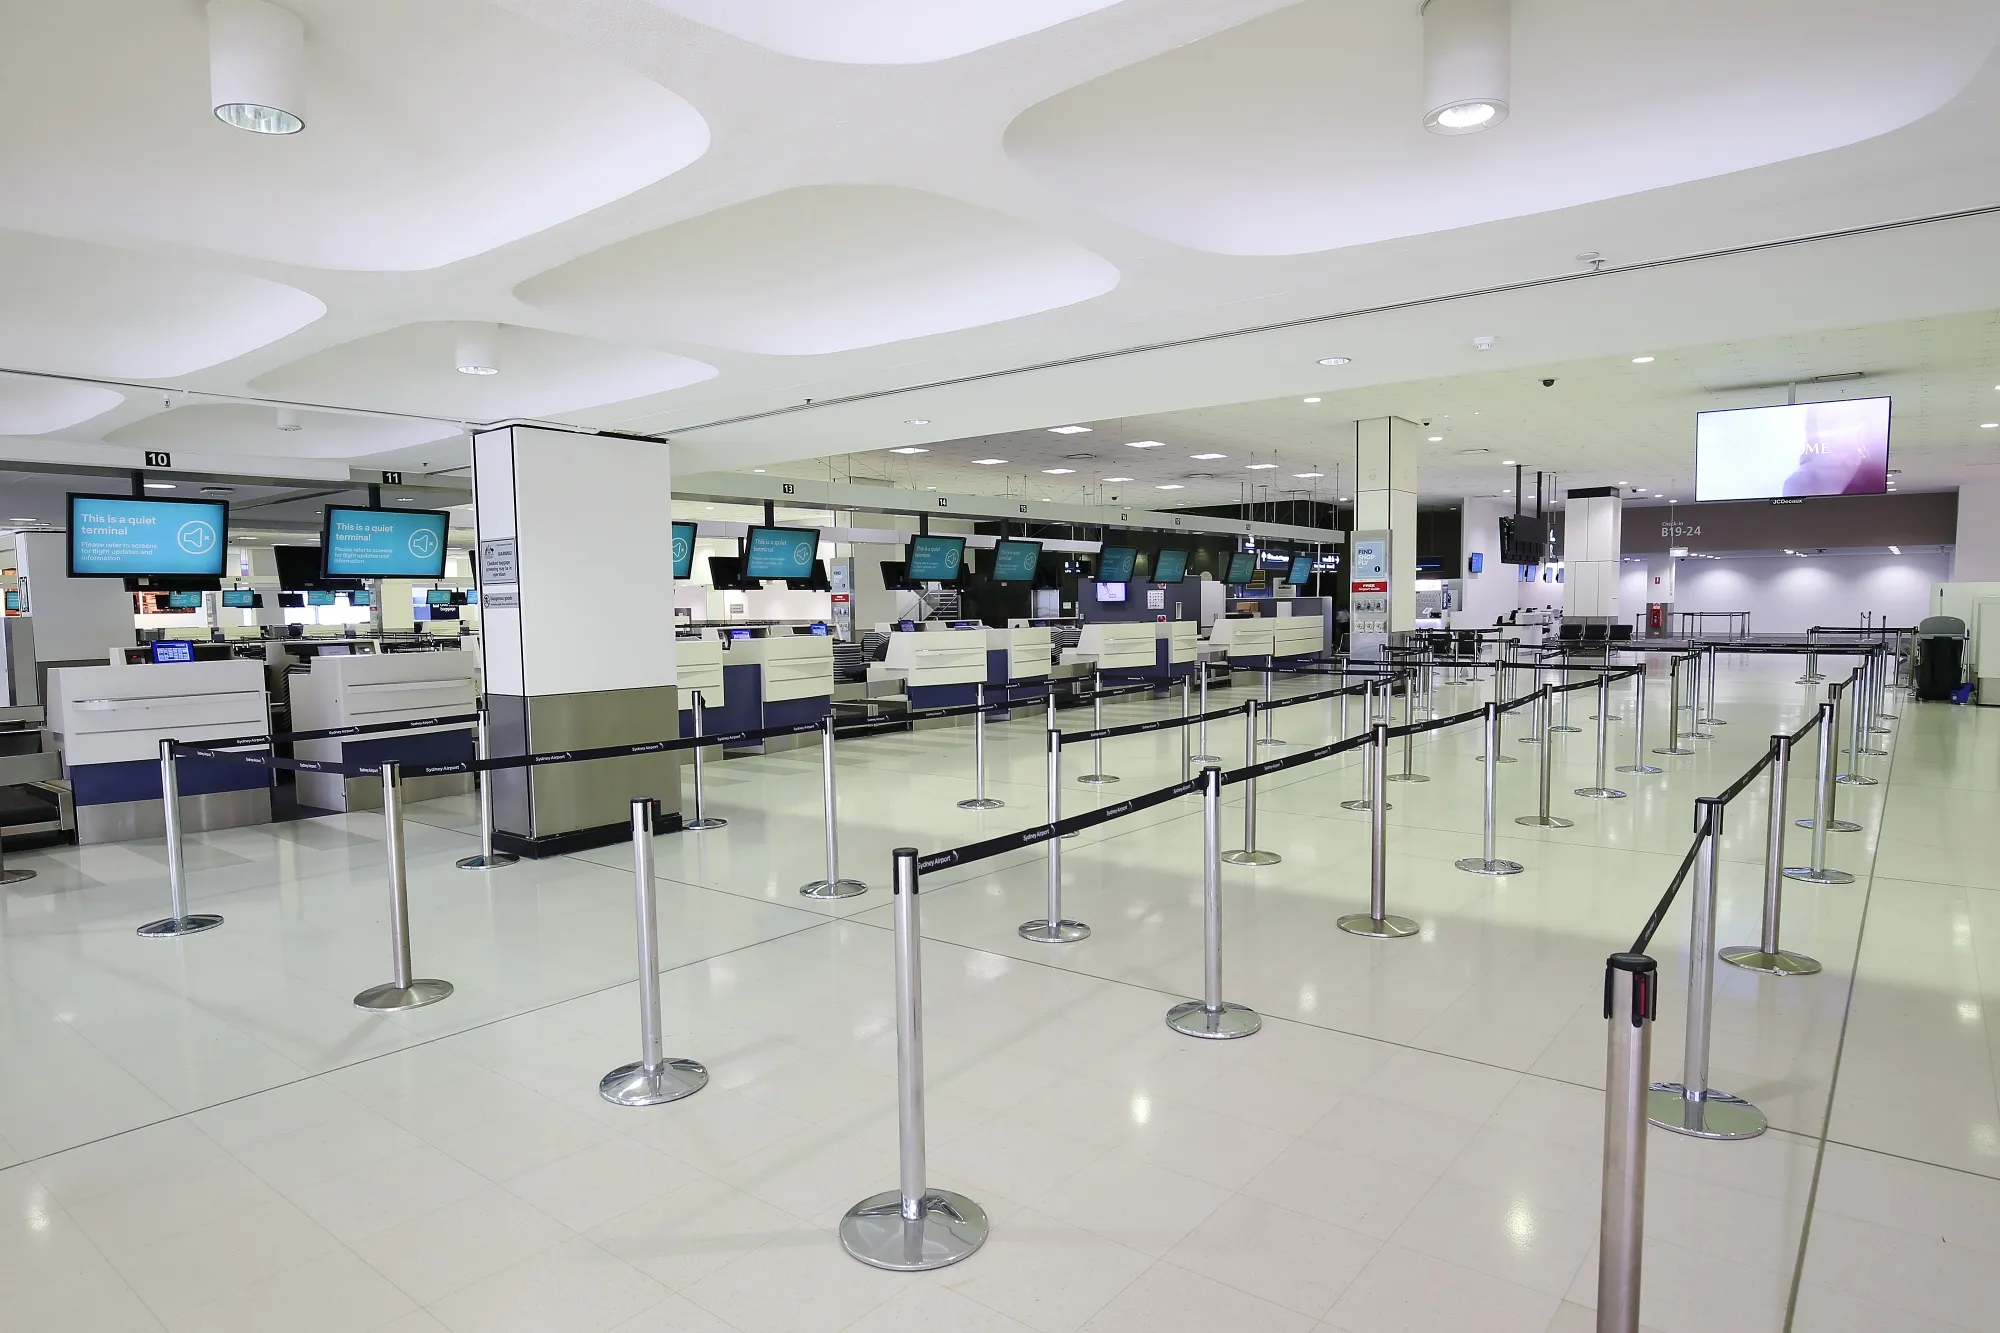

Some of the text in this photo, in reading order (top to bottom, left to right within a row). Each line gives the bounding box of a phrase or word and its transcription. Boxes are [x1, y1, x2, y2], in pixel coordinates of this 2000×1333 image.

[148, 453, 168, 466] 10
[386, 472, 399, 484] 11
[784, 484, 793, 493] 13
[81, 514, 105, 524] This
[108, 514, 118, 523] is
[128, 516, 156, 526] quiet
[81, 526, 128, 535] terminal
[336, 522, 354, 531] This
[372, 524, 394, 532] quiet
[1662, 526, 1702, 536] B19-24
[336, 534, 371, 542] terminal
[1022, 829, 1050, 842] Sydney Airport
[934, 855, 950, 864] Airport
